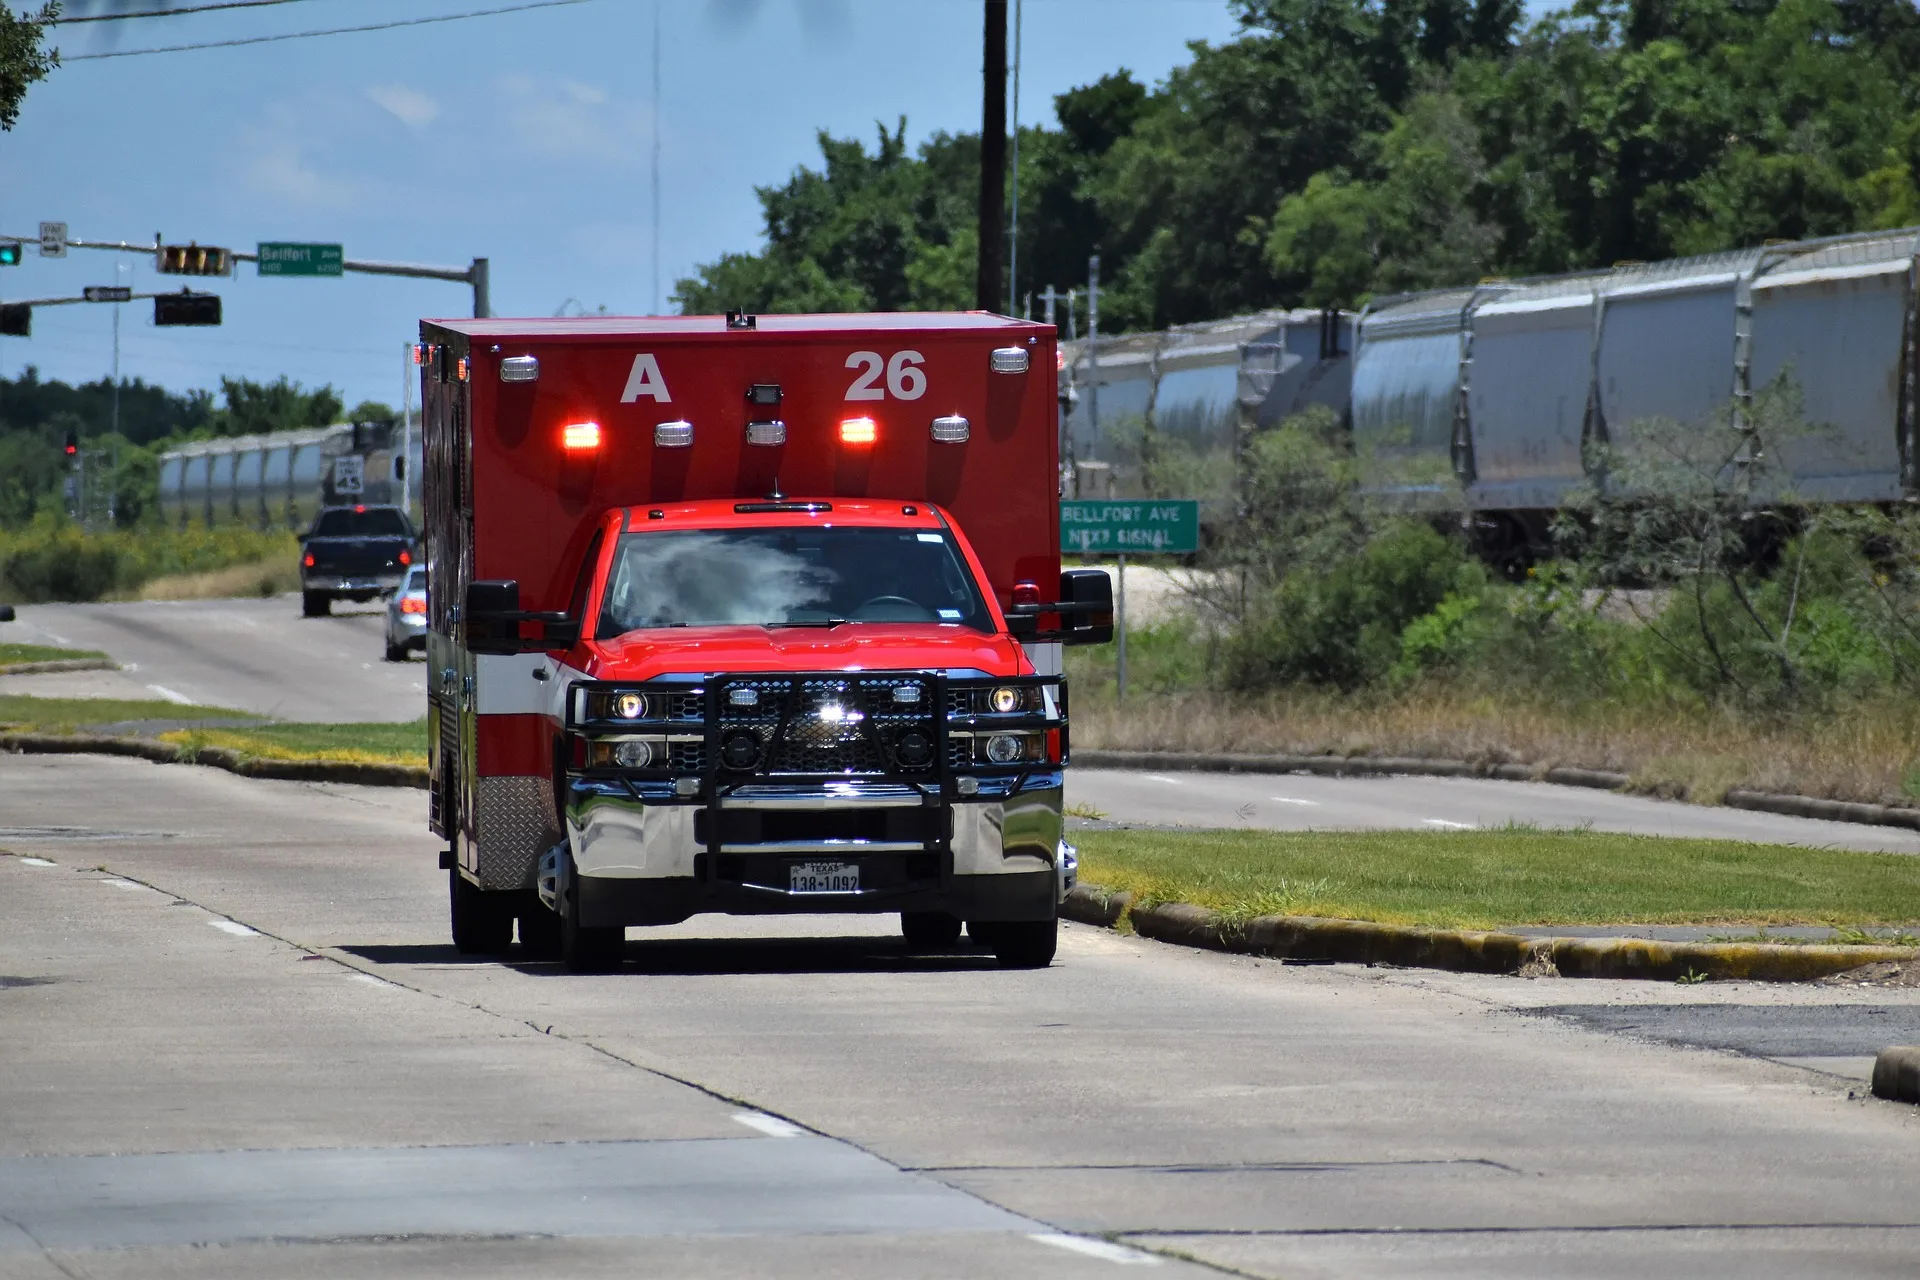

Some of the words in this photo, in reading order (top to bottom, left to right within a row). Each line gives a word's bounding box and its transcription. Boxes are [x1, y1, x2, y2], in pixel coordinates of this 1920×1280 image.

[620, 353, 672, 403] A
[844, 350, 927, 401] 26
[1062, 506, 1142, 523] BELLFORT
[1149, 506, 1180, 522] AVE
[1117, 529, 1174, 546] SIGNAL
[810, 865, 840, 873] TEXAS
